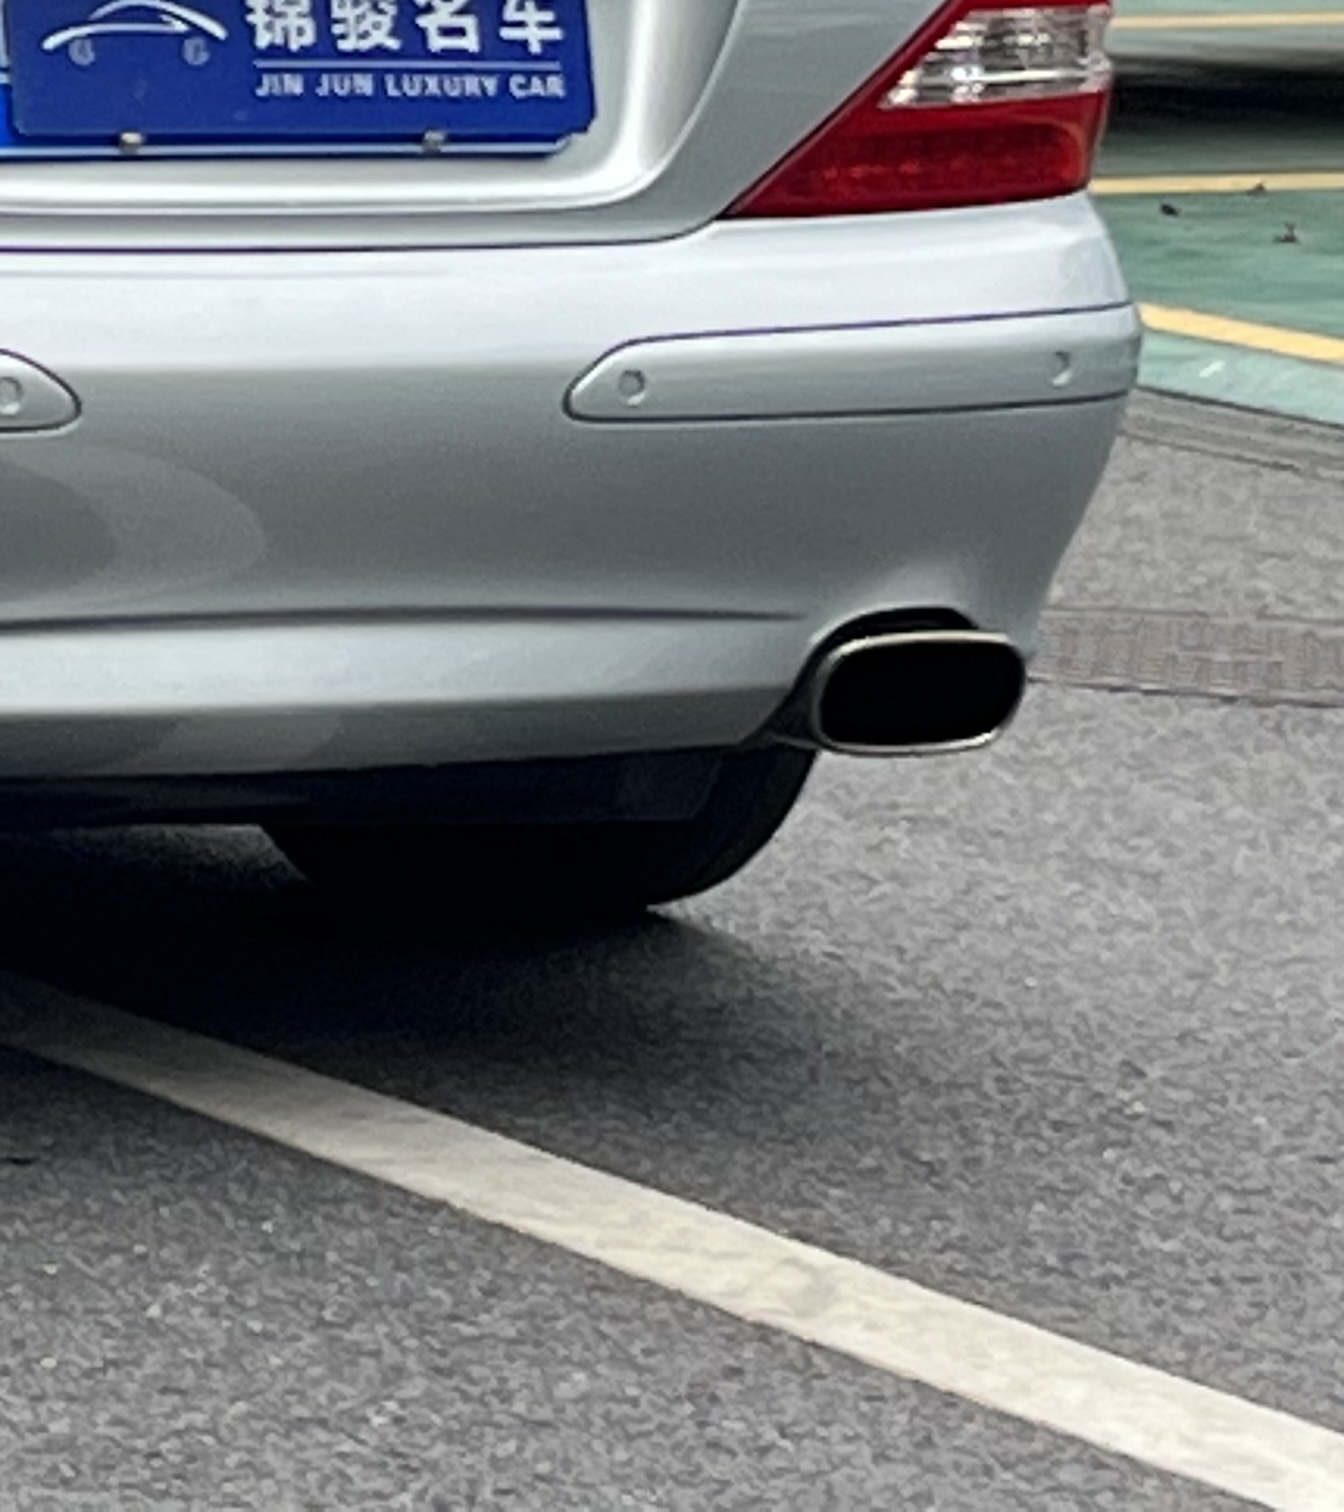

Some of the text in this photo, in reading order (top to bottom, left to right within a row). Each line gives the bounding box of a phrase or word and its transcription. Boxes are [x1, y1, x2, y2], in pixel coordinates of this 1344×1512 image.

[255, 73, 567, 99] JIN JUN LUXURY CAR
